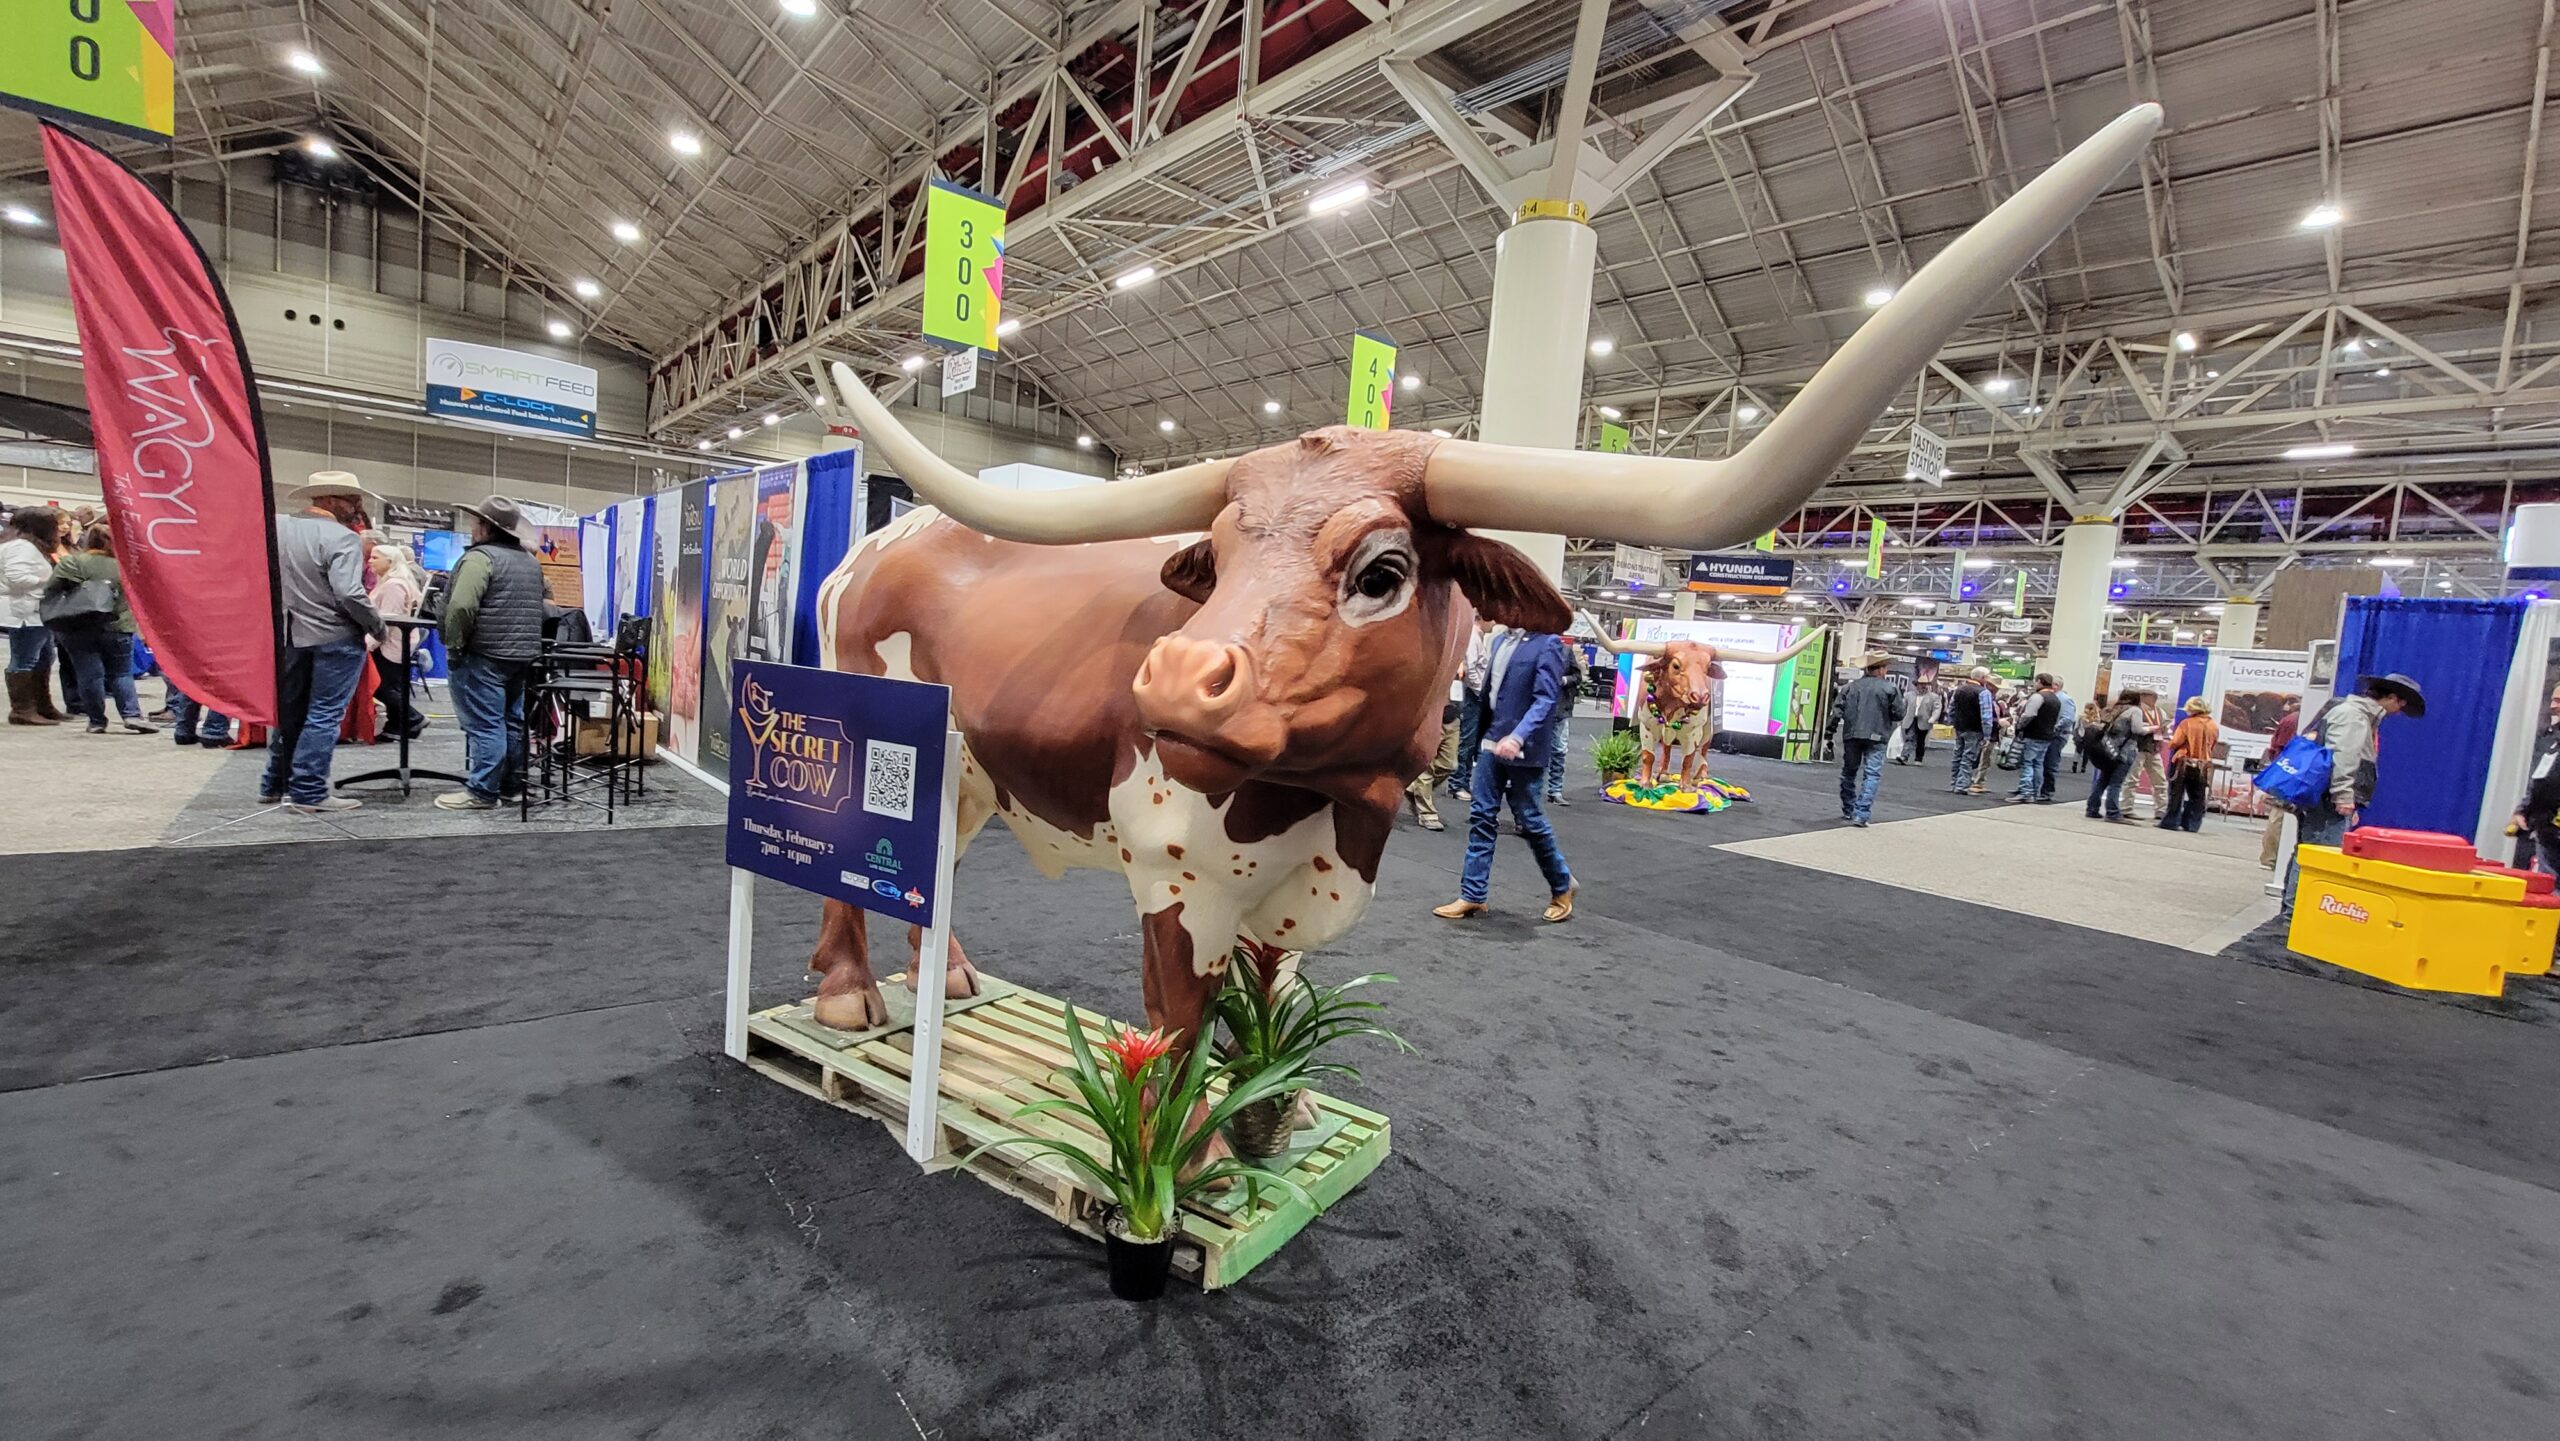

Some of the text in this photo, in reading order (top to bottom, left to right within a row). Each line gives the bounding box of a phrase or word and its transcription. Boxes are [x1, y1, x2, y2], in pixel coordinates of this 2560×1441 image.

[956, 219, 974, 322] 300
[465, 361, 595, 398] SMARTFEED
[483, 393, 556, 413] C-LOCK
[122, 344, 202, 555] WAGYU
[1913, 432, 1943, 461] TASTING
[1910, 451, 1942, 479] STATION
[721, 558, 748, 581] WORLD
[1616, 560, 1659, 576] DEMONSTRATION
[1708, 572, 1789, 582] CONSTRUCTION EQUIPMENT
[1709, 562, 1766, 575] HYUNDAI
[712, 581, 748, 602] OPPORTUNITY
[2120, 673, 2169, 685] PROCESS
[2231, 665, 2305, 680] Livestock
[779, 710, 808, 732] THE
[769, 729, 843, 764] SECRET
[769, 756, 838, 798] COW
[742, 817, 835, 855] Thursday, February 2
[760, 841, 780, 856] 7pm
[864, 852, 904, 871] CENTRAL
[2319, 894, 2369, 921] Ritchie
